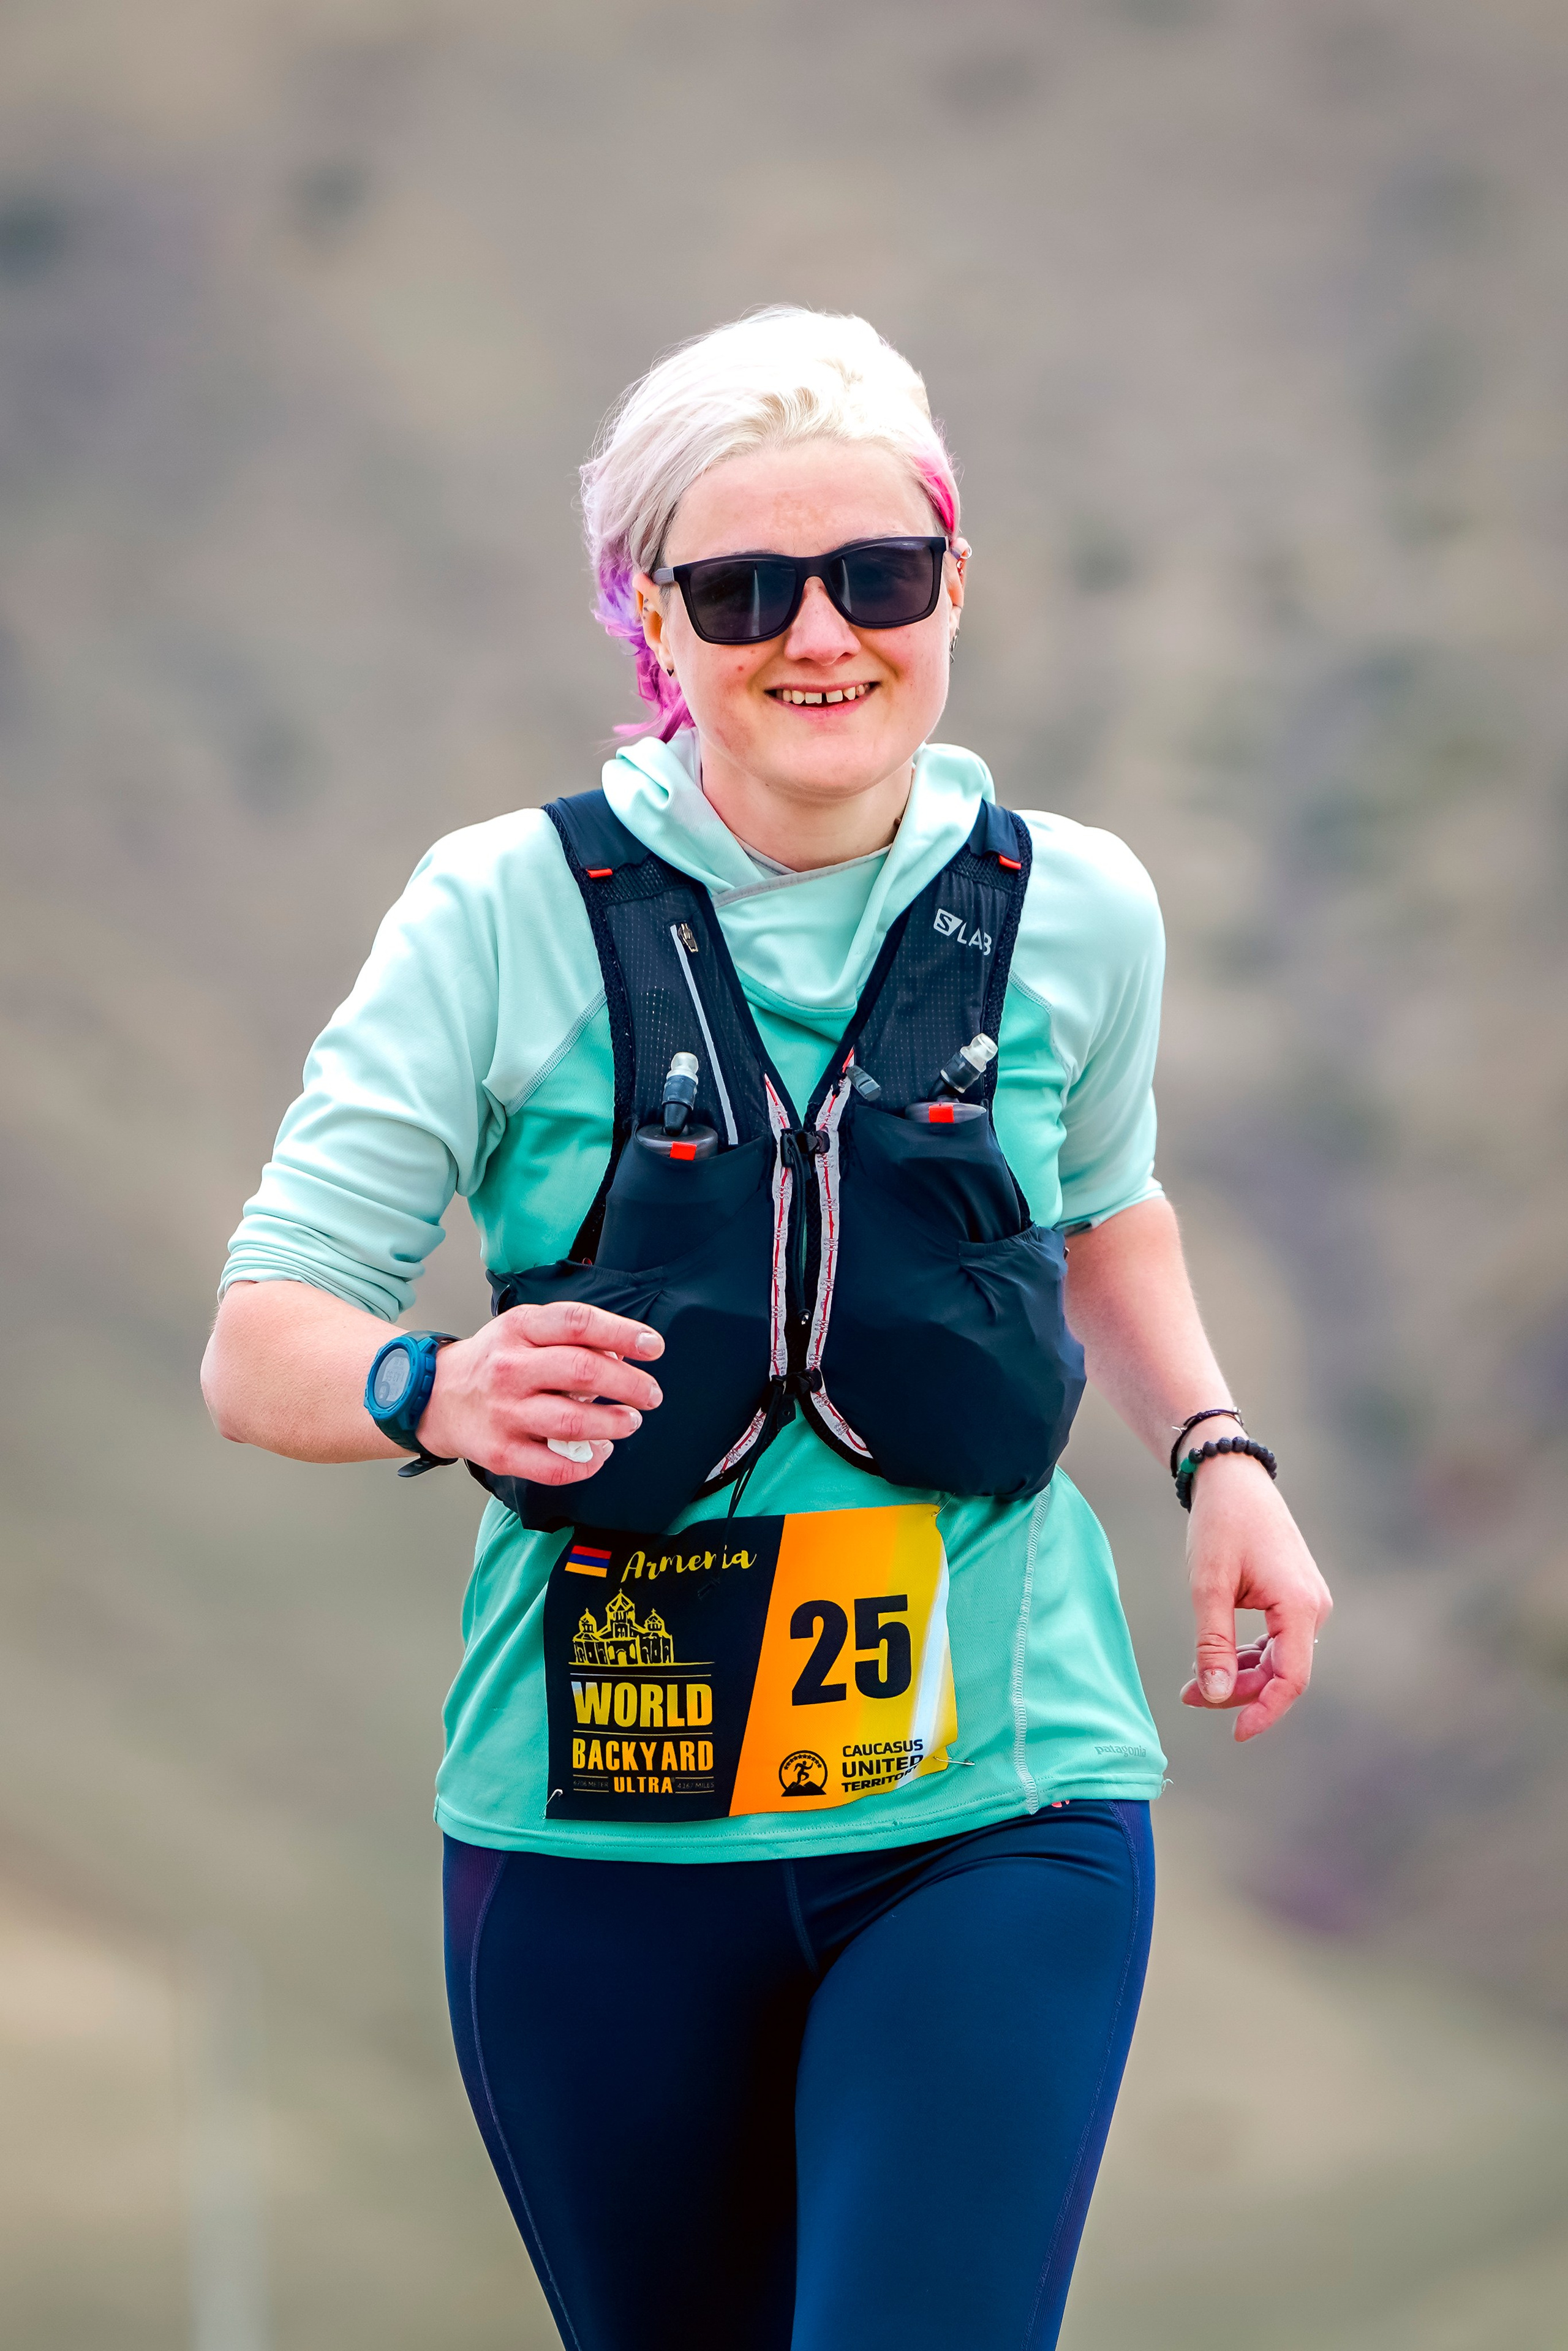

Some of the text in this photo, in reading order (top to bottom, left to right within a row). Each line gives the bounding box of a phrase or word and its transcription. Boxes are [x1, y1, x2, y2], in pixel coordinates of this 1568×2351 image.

[620, 1544, 757, 1583] Armenia
[790, 1594, 911, 1706] 25
[571, 1681, 713, 1727] WORLD
[572, 1738, 714, 1771] BACKYARD
[843, 1738, 924, 1757] CAUCASUS
[1095, 1745, 1147, 1757] patagonia
[842, 1754, 924, 1778] UNITED
[614, 1776, 673, 1793] ULTRA
